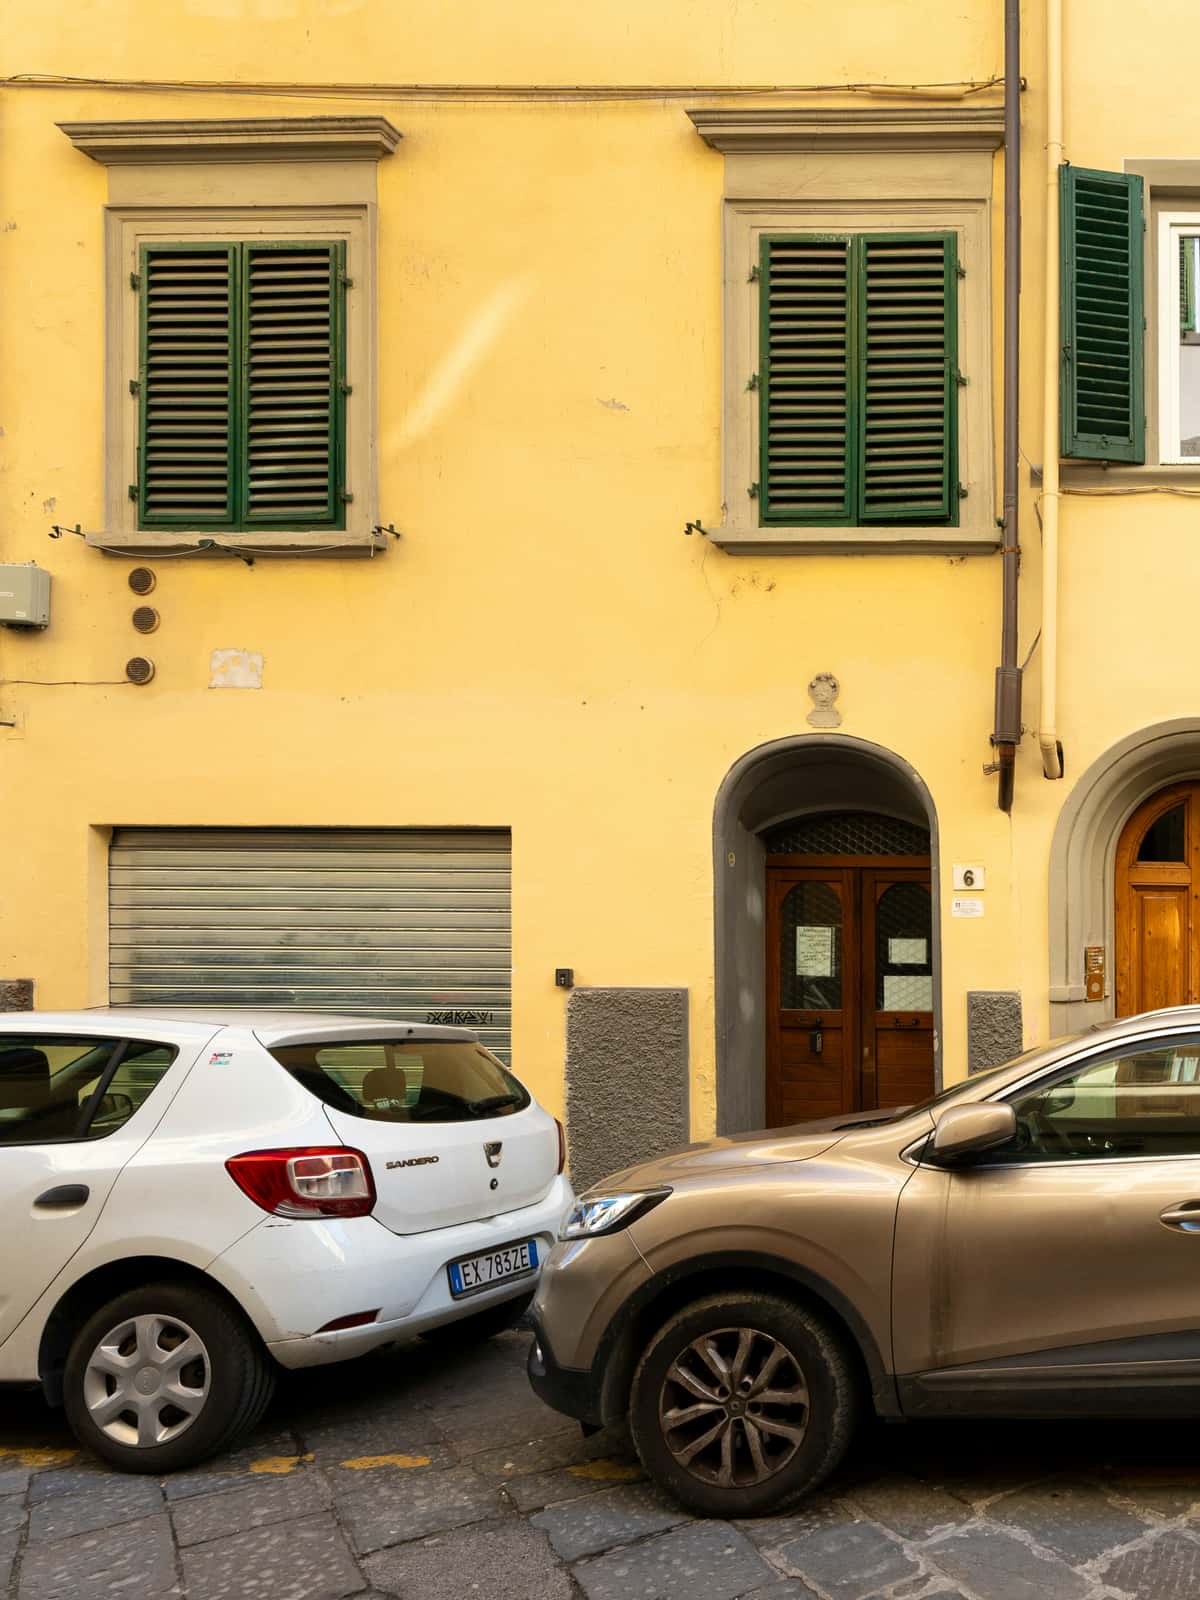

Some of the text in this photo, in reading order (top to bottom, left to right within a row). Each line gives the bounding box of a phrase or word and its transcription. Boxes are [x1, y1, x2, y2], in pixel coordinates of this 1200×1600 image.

[963, 869, 975, 887] 6
[385, 1155, 440, 1170] SANDERO
[461, 1260, 482, 1286] EX
[485, 1246, 529, 1279] 783ZE
